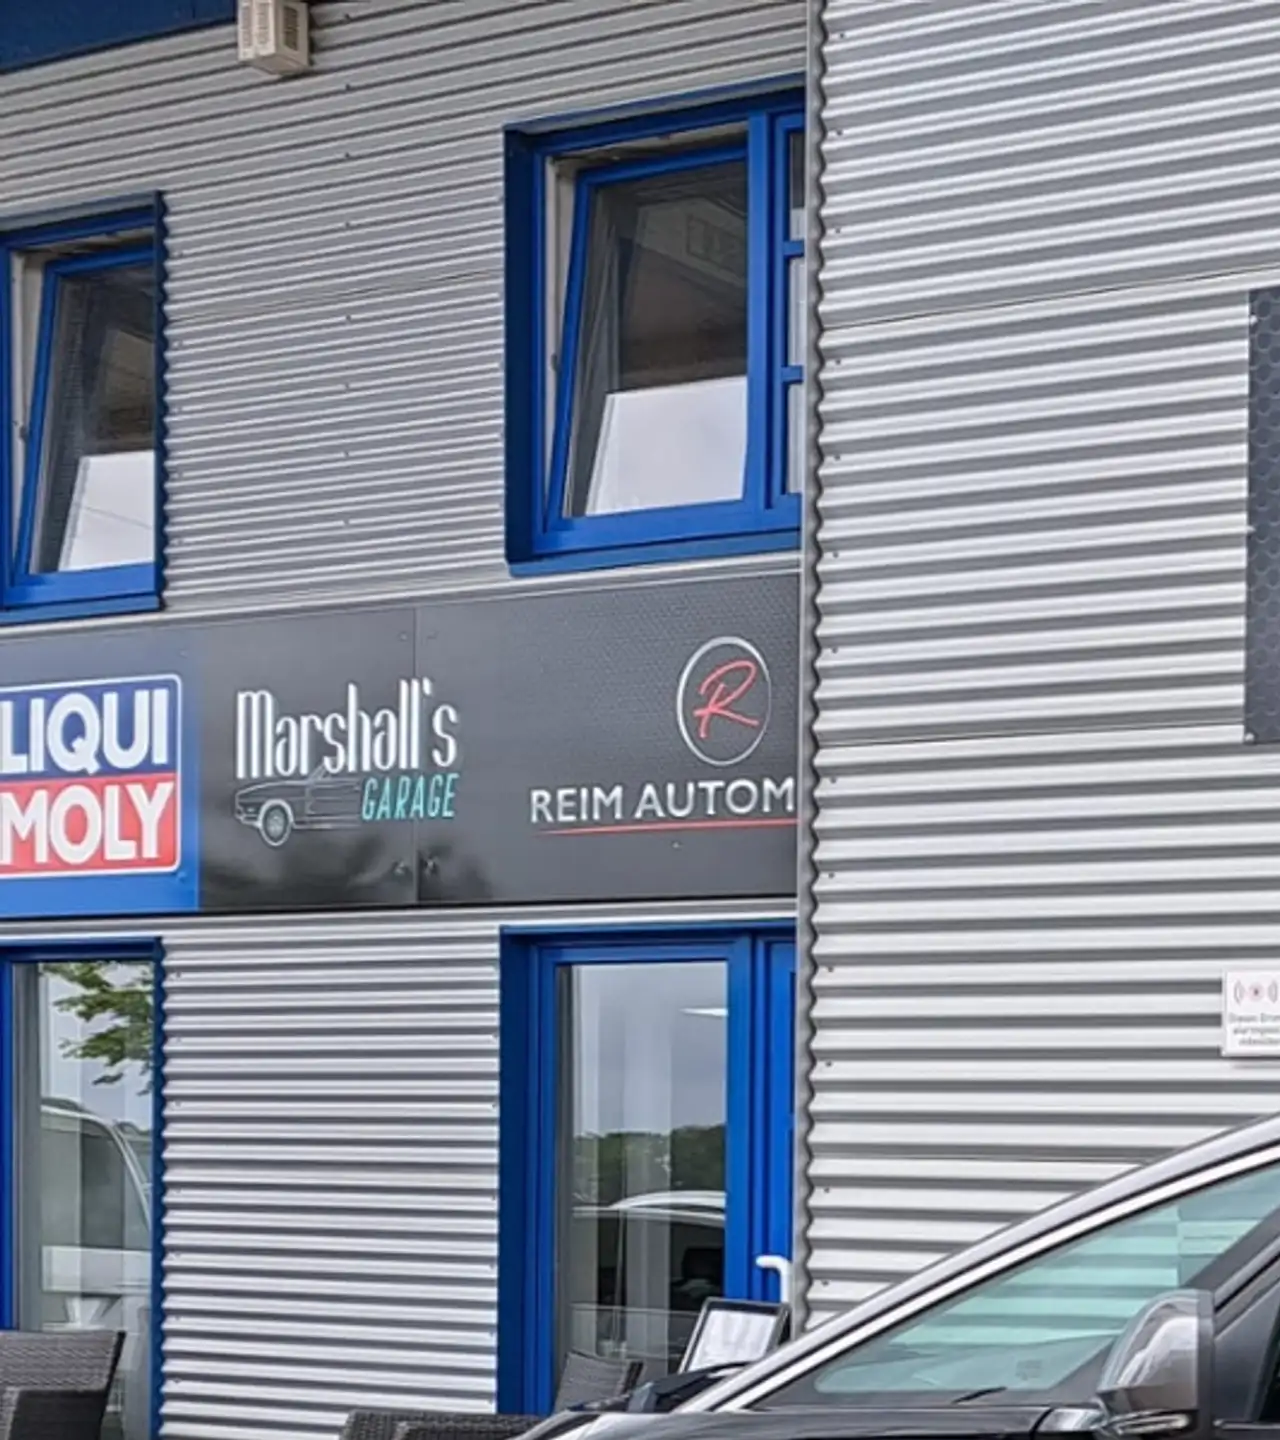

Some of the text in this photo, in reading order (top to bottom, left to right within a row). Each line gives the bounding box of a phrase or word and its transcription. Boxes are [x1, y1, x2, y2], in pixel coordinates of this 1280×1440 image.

[0, 689, 169, 774] LIQUI
[236, 676, 460, 779] Marshall's
[0, 782, 174, 866] MOLY
[361, 773, 459, 820] GARAGE
[530, 784, 624, 823] REIM
